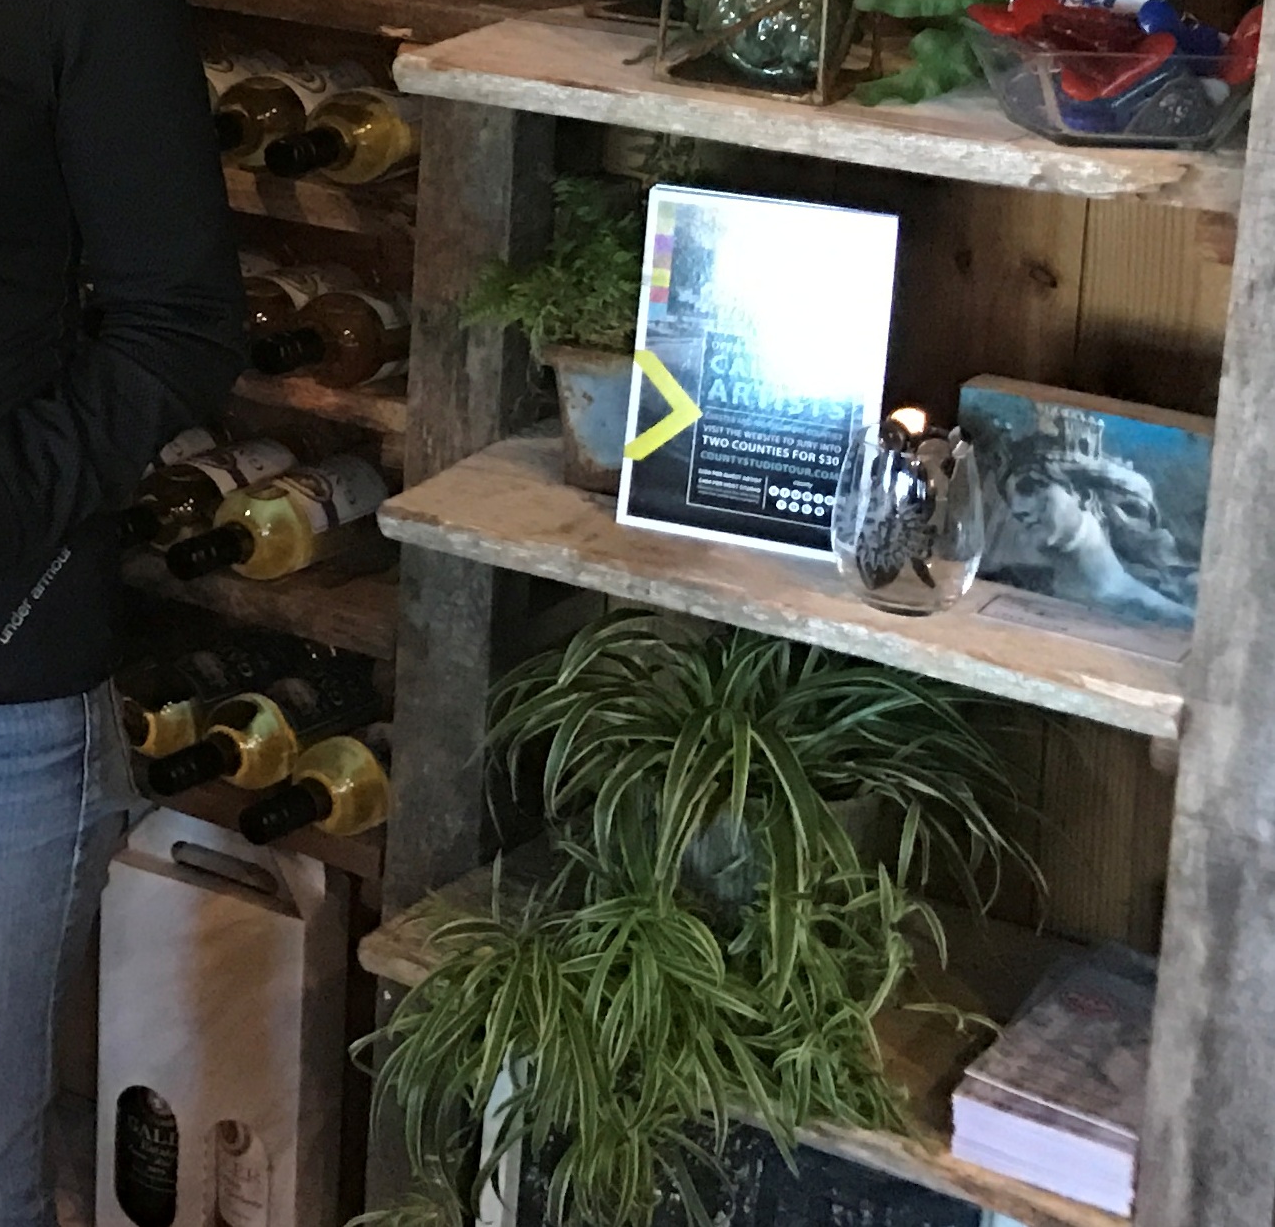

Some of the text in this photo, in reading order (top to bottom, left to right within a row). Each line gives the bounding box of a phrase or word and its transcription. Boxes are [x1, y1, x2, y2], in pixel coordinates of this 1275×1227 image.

[702, 424, 724, 434] VISIT
[726, 427, 742, 438] THE
[744, 430, 781, 444] WEBSITE
[783, 436, 795, 446] TO
[819, 443, 842, 454] INTO
[702, 434, 840, 467] TWO COUNTIES FOR $30
[700, 450, 840, 481] COUNTYSTUDIOTOUR.COM
[30, 545, 71, 600] armour
